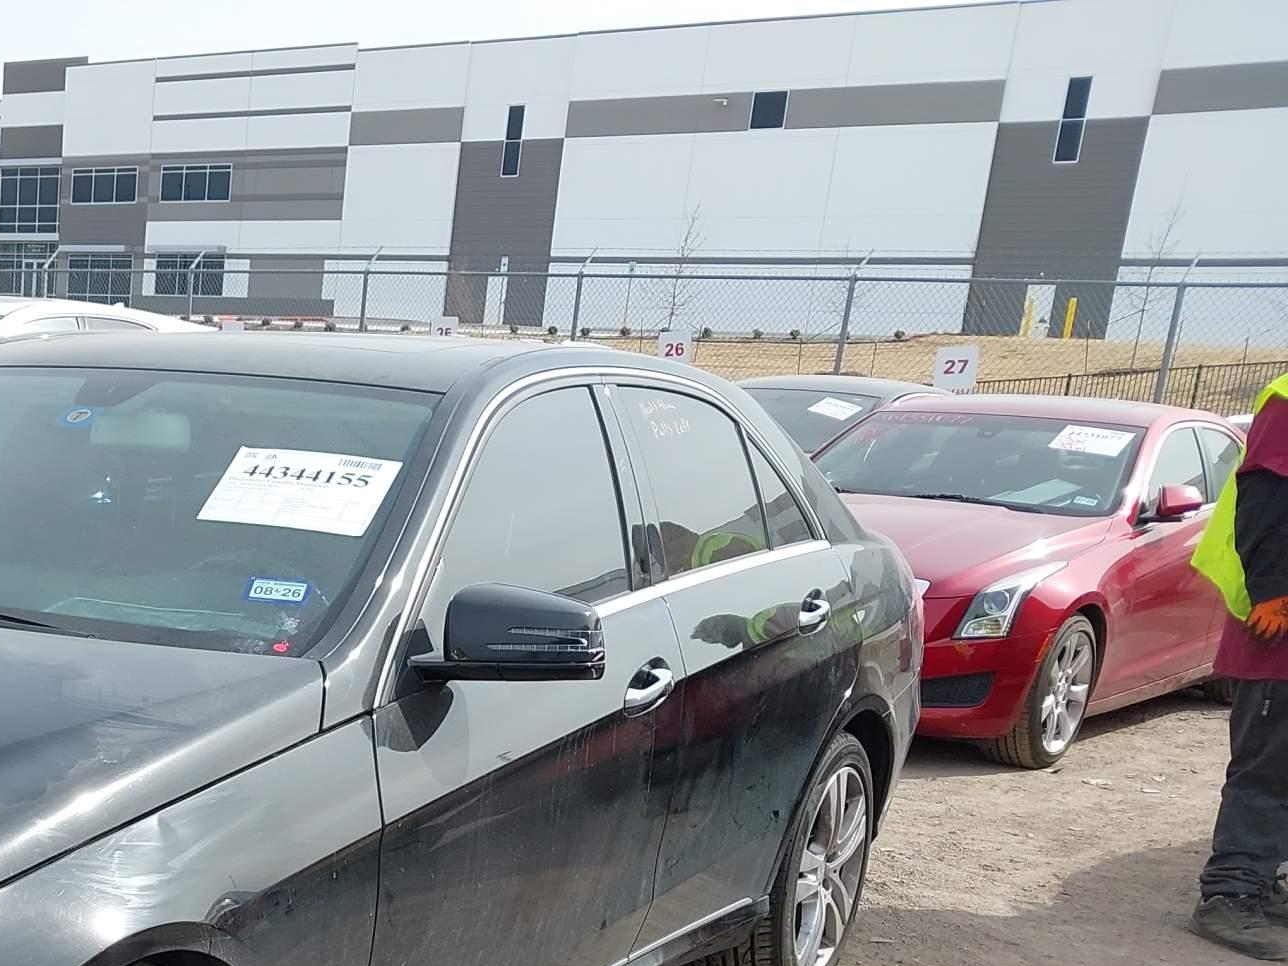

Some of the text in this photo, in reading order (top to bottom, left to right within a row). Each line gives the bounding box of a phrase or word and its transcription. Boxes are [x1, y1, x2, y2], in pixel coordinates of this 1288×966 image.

[664, 342, 685, 357] 26
[943, 359, 969, 374] 27
[243, 463, 373, 488] 44344155
